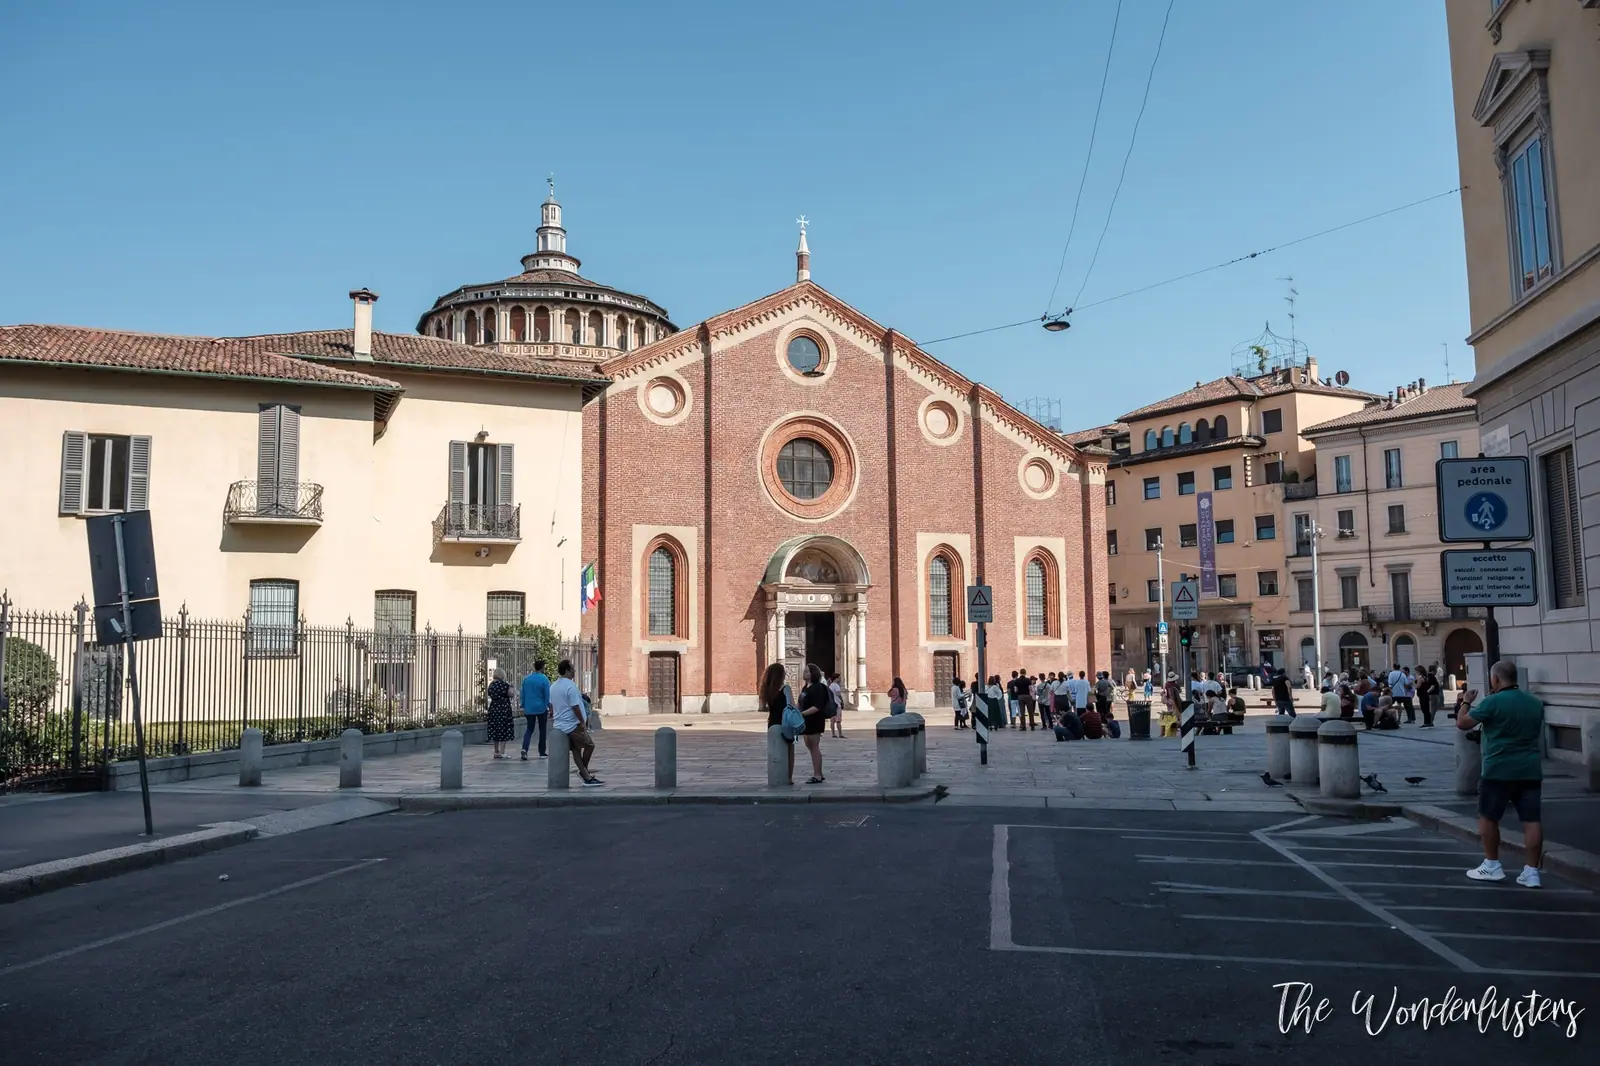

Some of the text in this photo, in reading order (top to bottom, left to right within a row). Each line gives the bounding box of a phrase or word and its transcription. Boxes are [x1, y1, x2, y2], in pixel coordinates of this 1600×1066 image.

[1470, 466, 1496, 474] area
[1457, 475, 1512, 488] pedonale
[1472, 554, 1507, 562] eccetto
